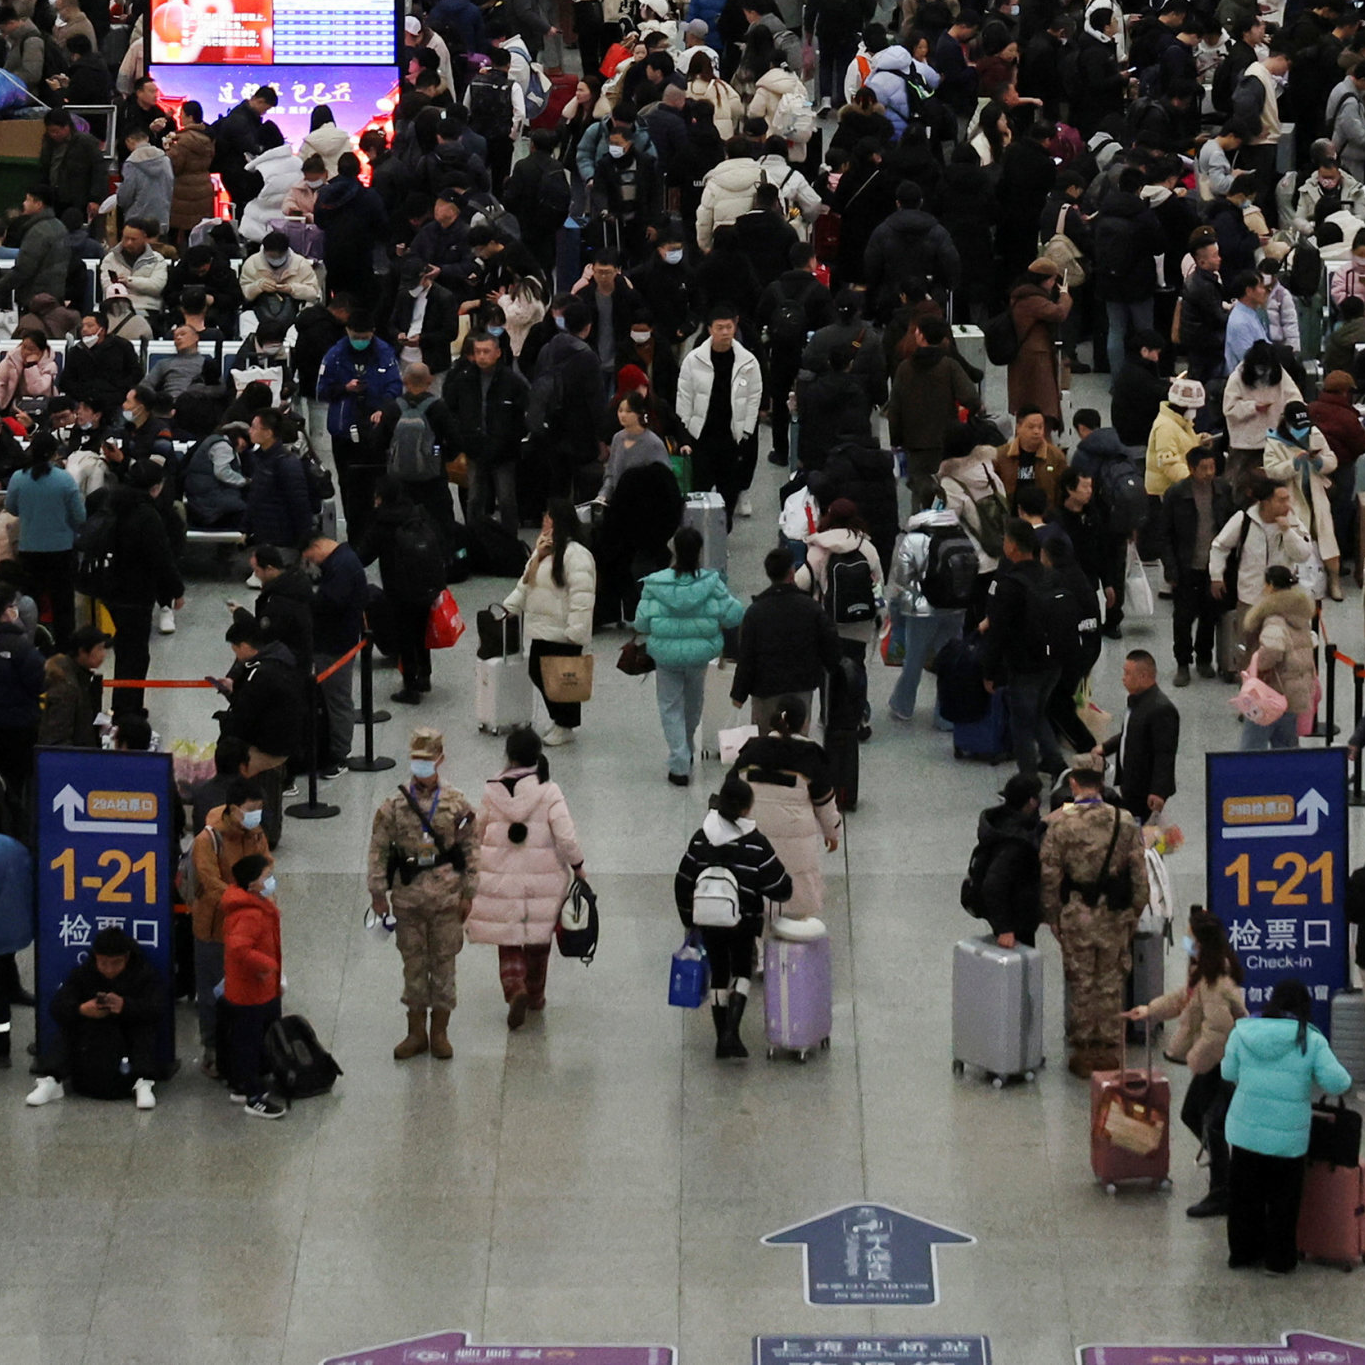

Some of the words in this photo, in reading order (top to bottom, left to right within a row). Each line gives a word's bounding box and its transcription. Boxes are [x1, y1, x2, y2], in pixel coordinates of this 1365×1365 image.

[50, 847, 157, 905] 1-21
[1224, 851, 1334, 906] 1-21
[1228, 918, 1331, 951] 检票口
[1246, 954, 1313, 970] Check-in
